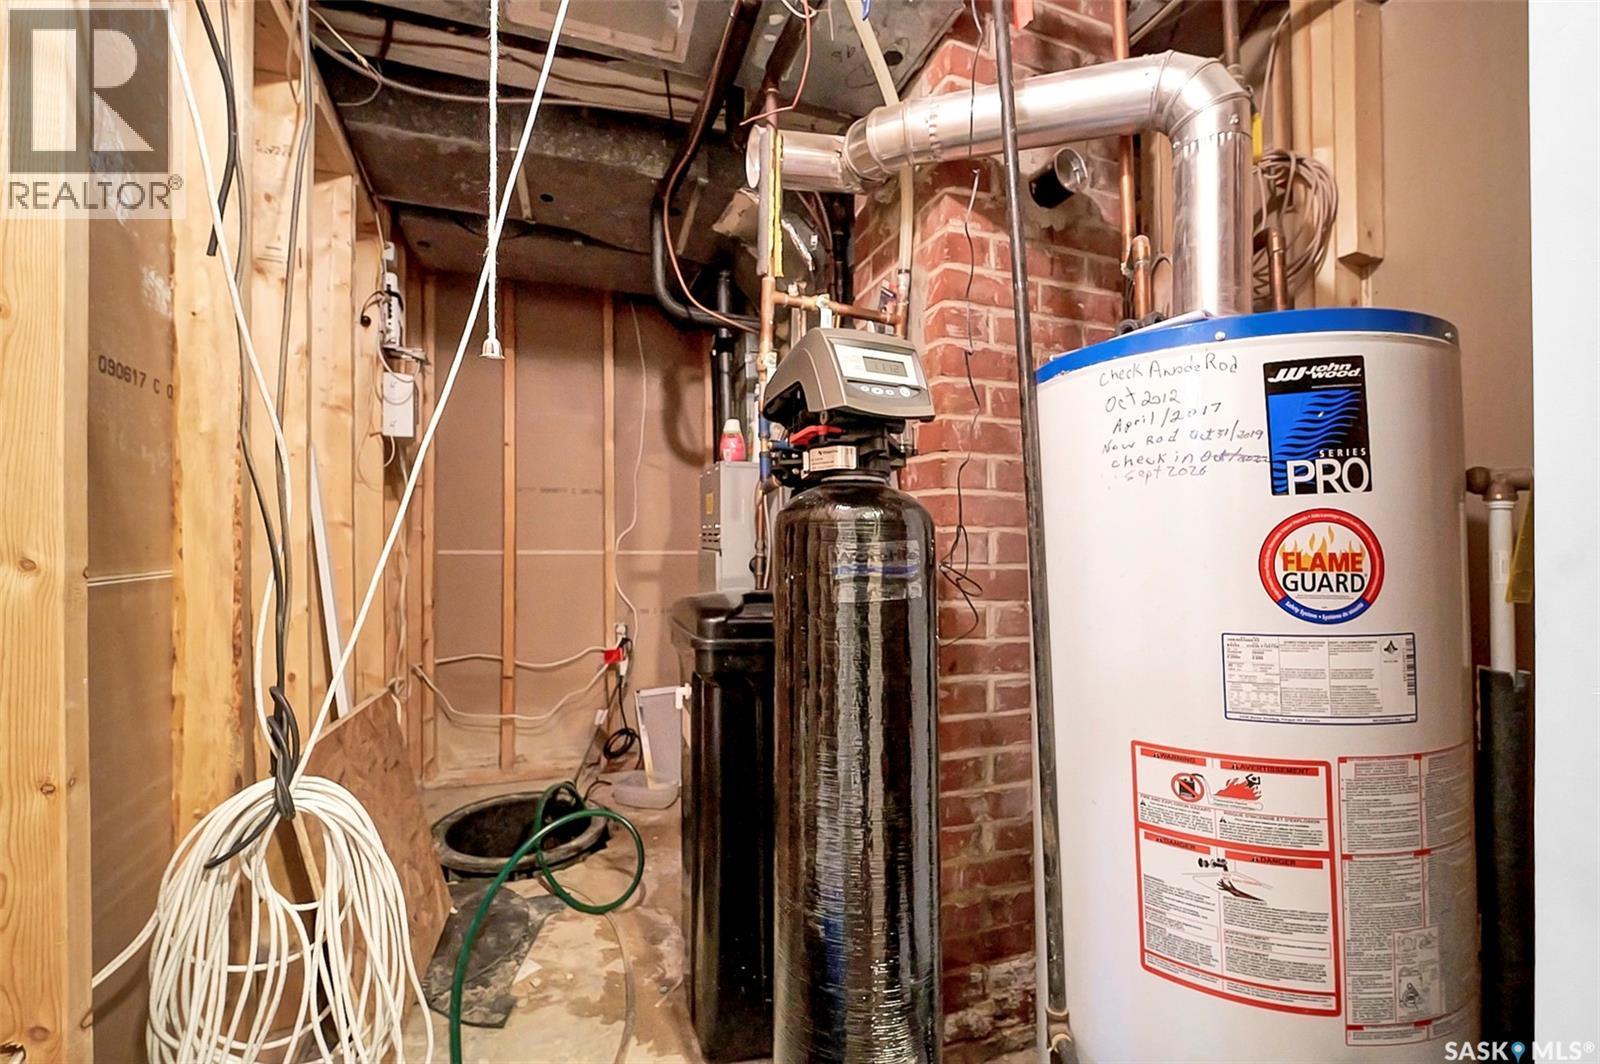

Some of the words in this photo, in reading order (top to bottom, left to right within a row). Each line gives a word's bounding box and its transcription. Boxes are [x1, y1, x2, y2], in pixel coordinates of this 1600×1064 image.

[1205, 352, 1238, 373] Rod
[98, 354, 147, 388] 090617
[153, 378, 160, 395] C
[1105, 386, 1136, 412] Oct
[1141, 389, 1181, 406] 2012
[1174, 451, 1194, 464] in
[1319, 447, 1367, 457] SERIES
[1286, 457, 1369, 495] PRO
[1282, 552, 1363, 572] FLAME
[1160, 753, 1196, 763] WARNING
